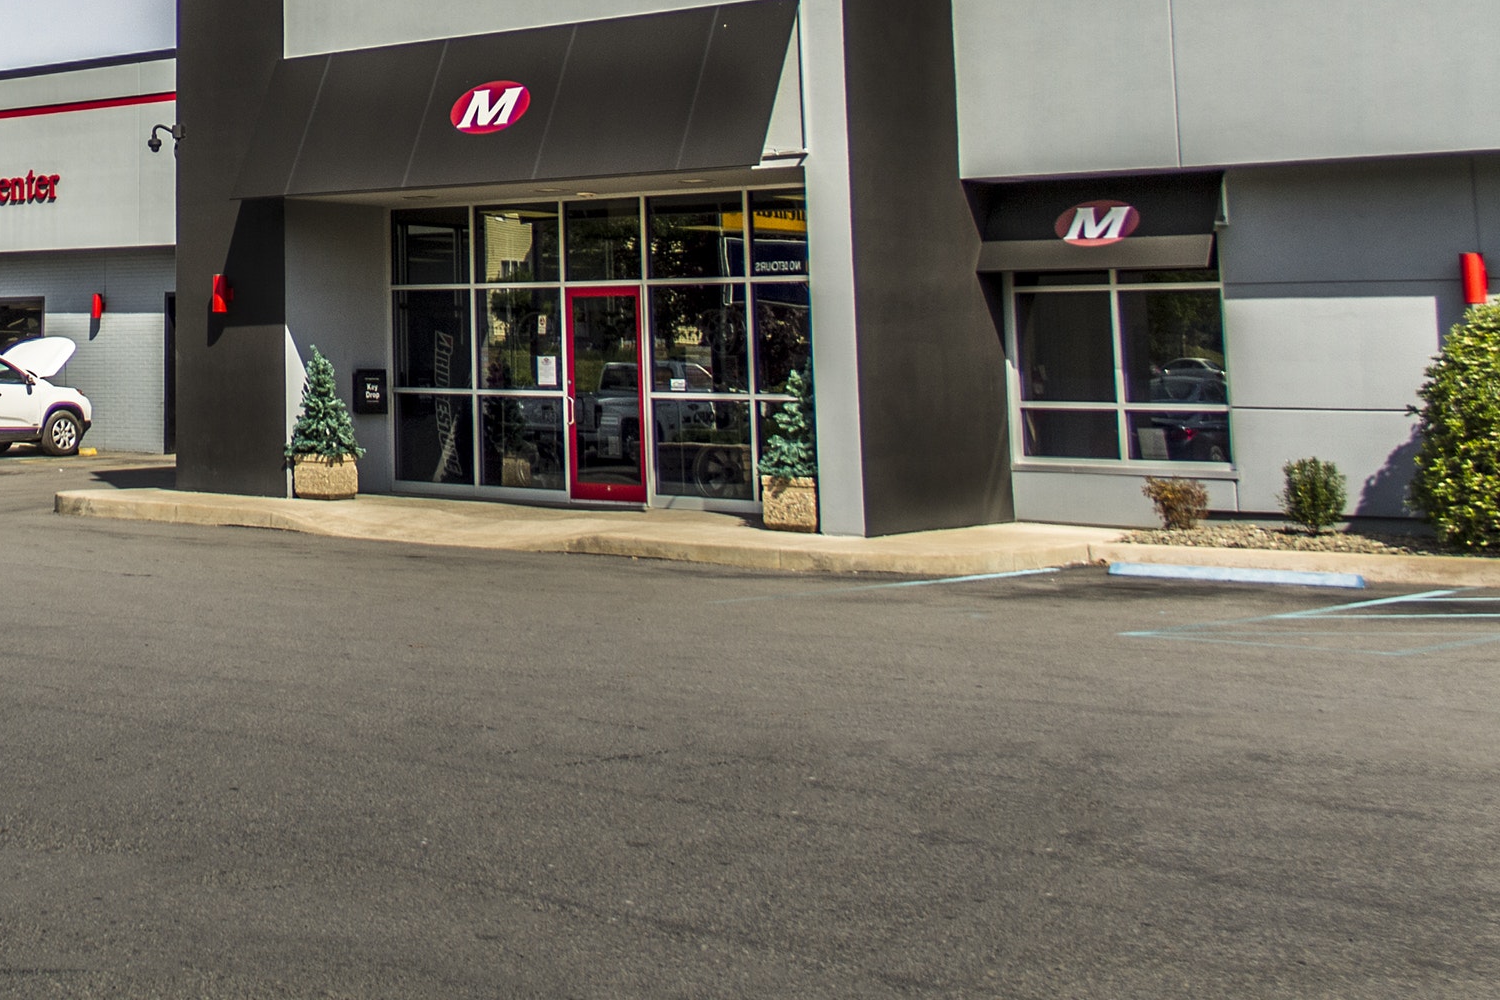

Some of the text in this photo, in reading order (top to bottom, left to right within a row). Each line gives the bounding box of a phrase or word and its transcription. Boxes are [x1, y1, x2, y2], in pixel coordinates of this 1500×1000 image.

[456, 86, 524, 129] M
[1063, 206, 1130, 240] M
[365, 391, 380, 399] Drop
[366, 383, 378, 391] Key
